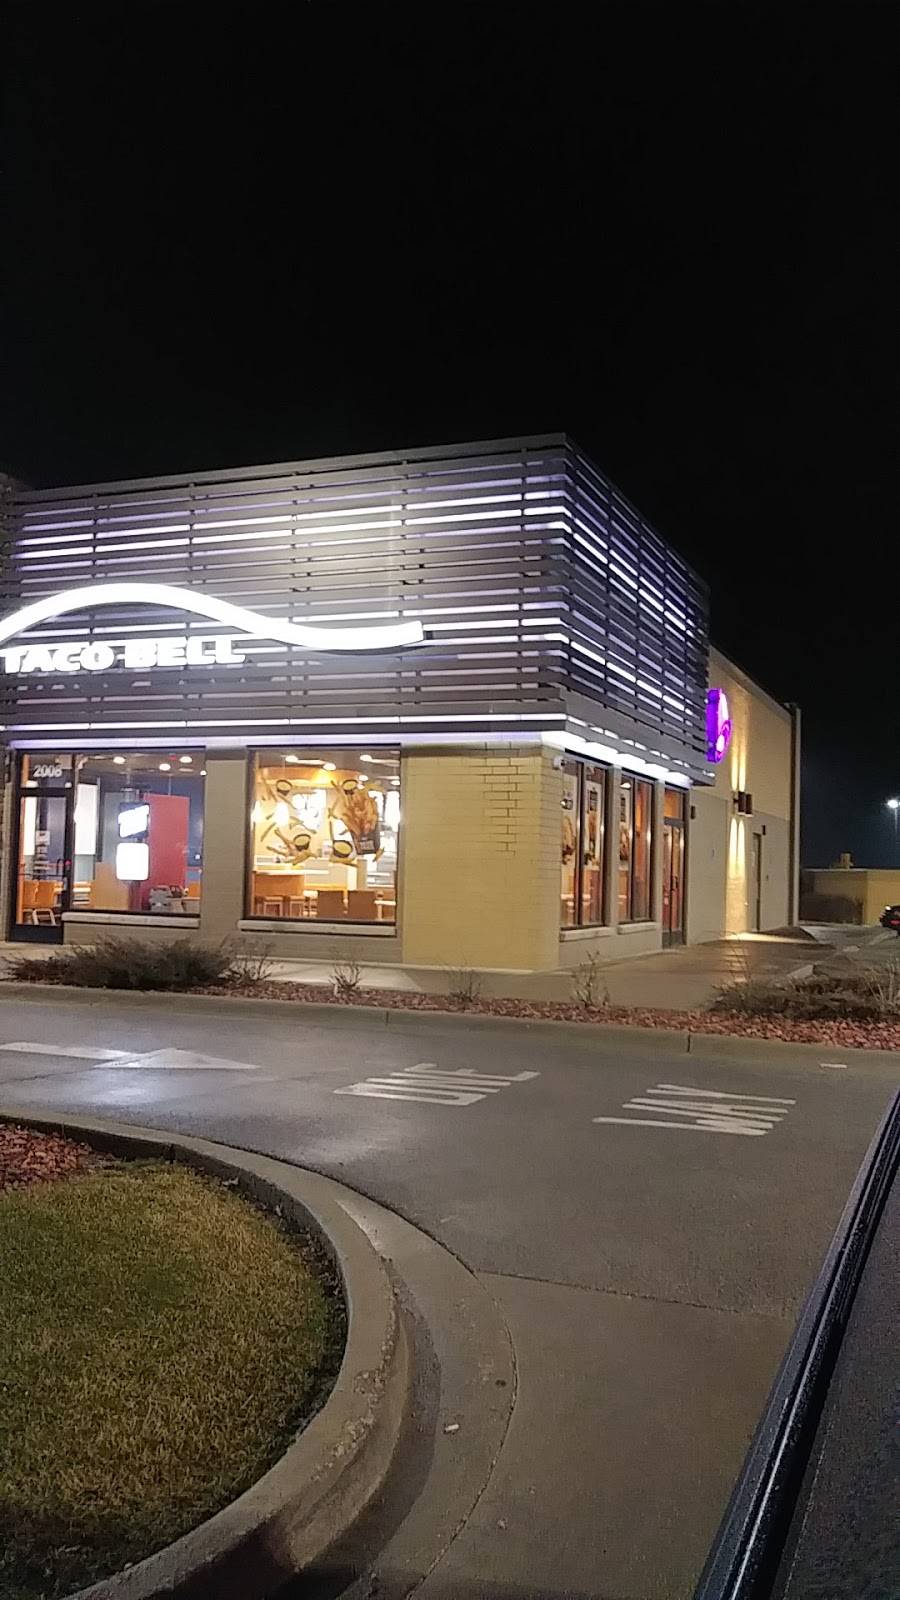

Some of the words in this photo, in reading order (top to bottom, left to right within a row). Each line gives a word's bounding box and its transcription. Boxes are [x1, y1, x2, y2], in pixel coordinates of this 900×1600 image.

[4, 646, 115, 673] TACO
[124, 638, 246, 668] BELL
[333, 1063, 541, 1106] ONE
[592, 1084, 796, 1136] WAY
